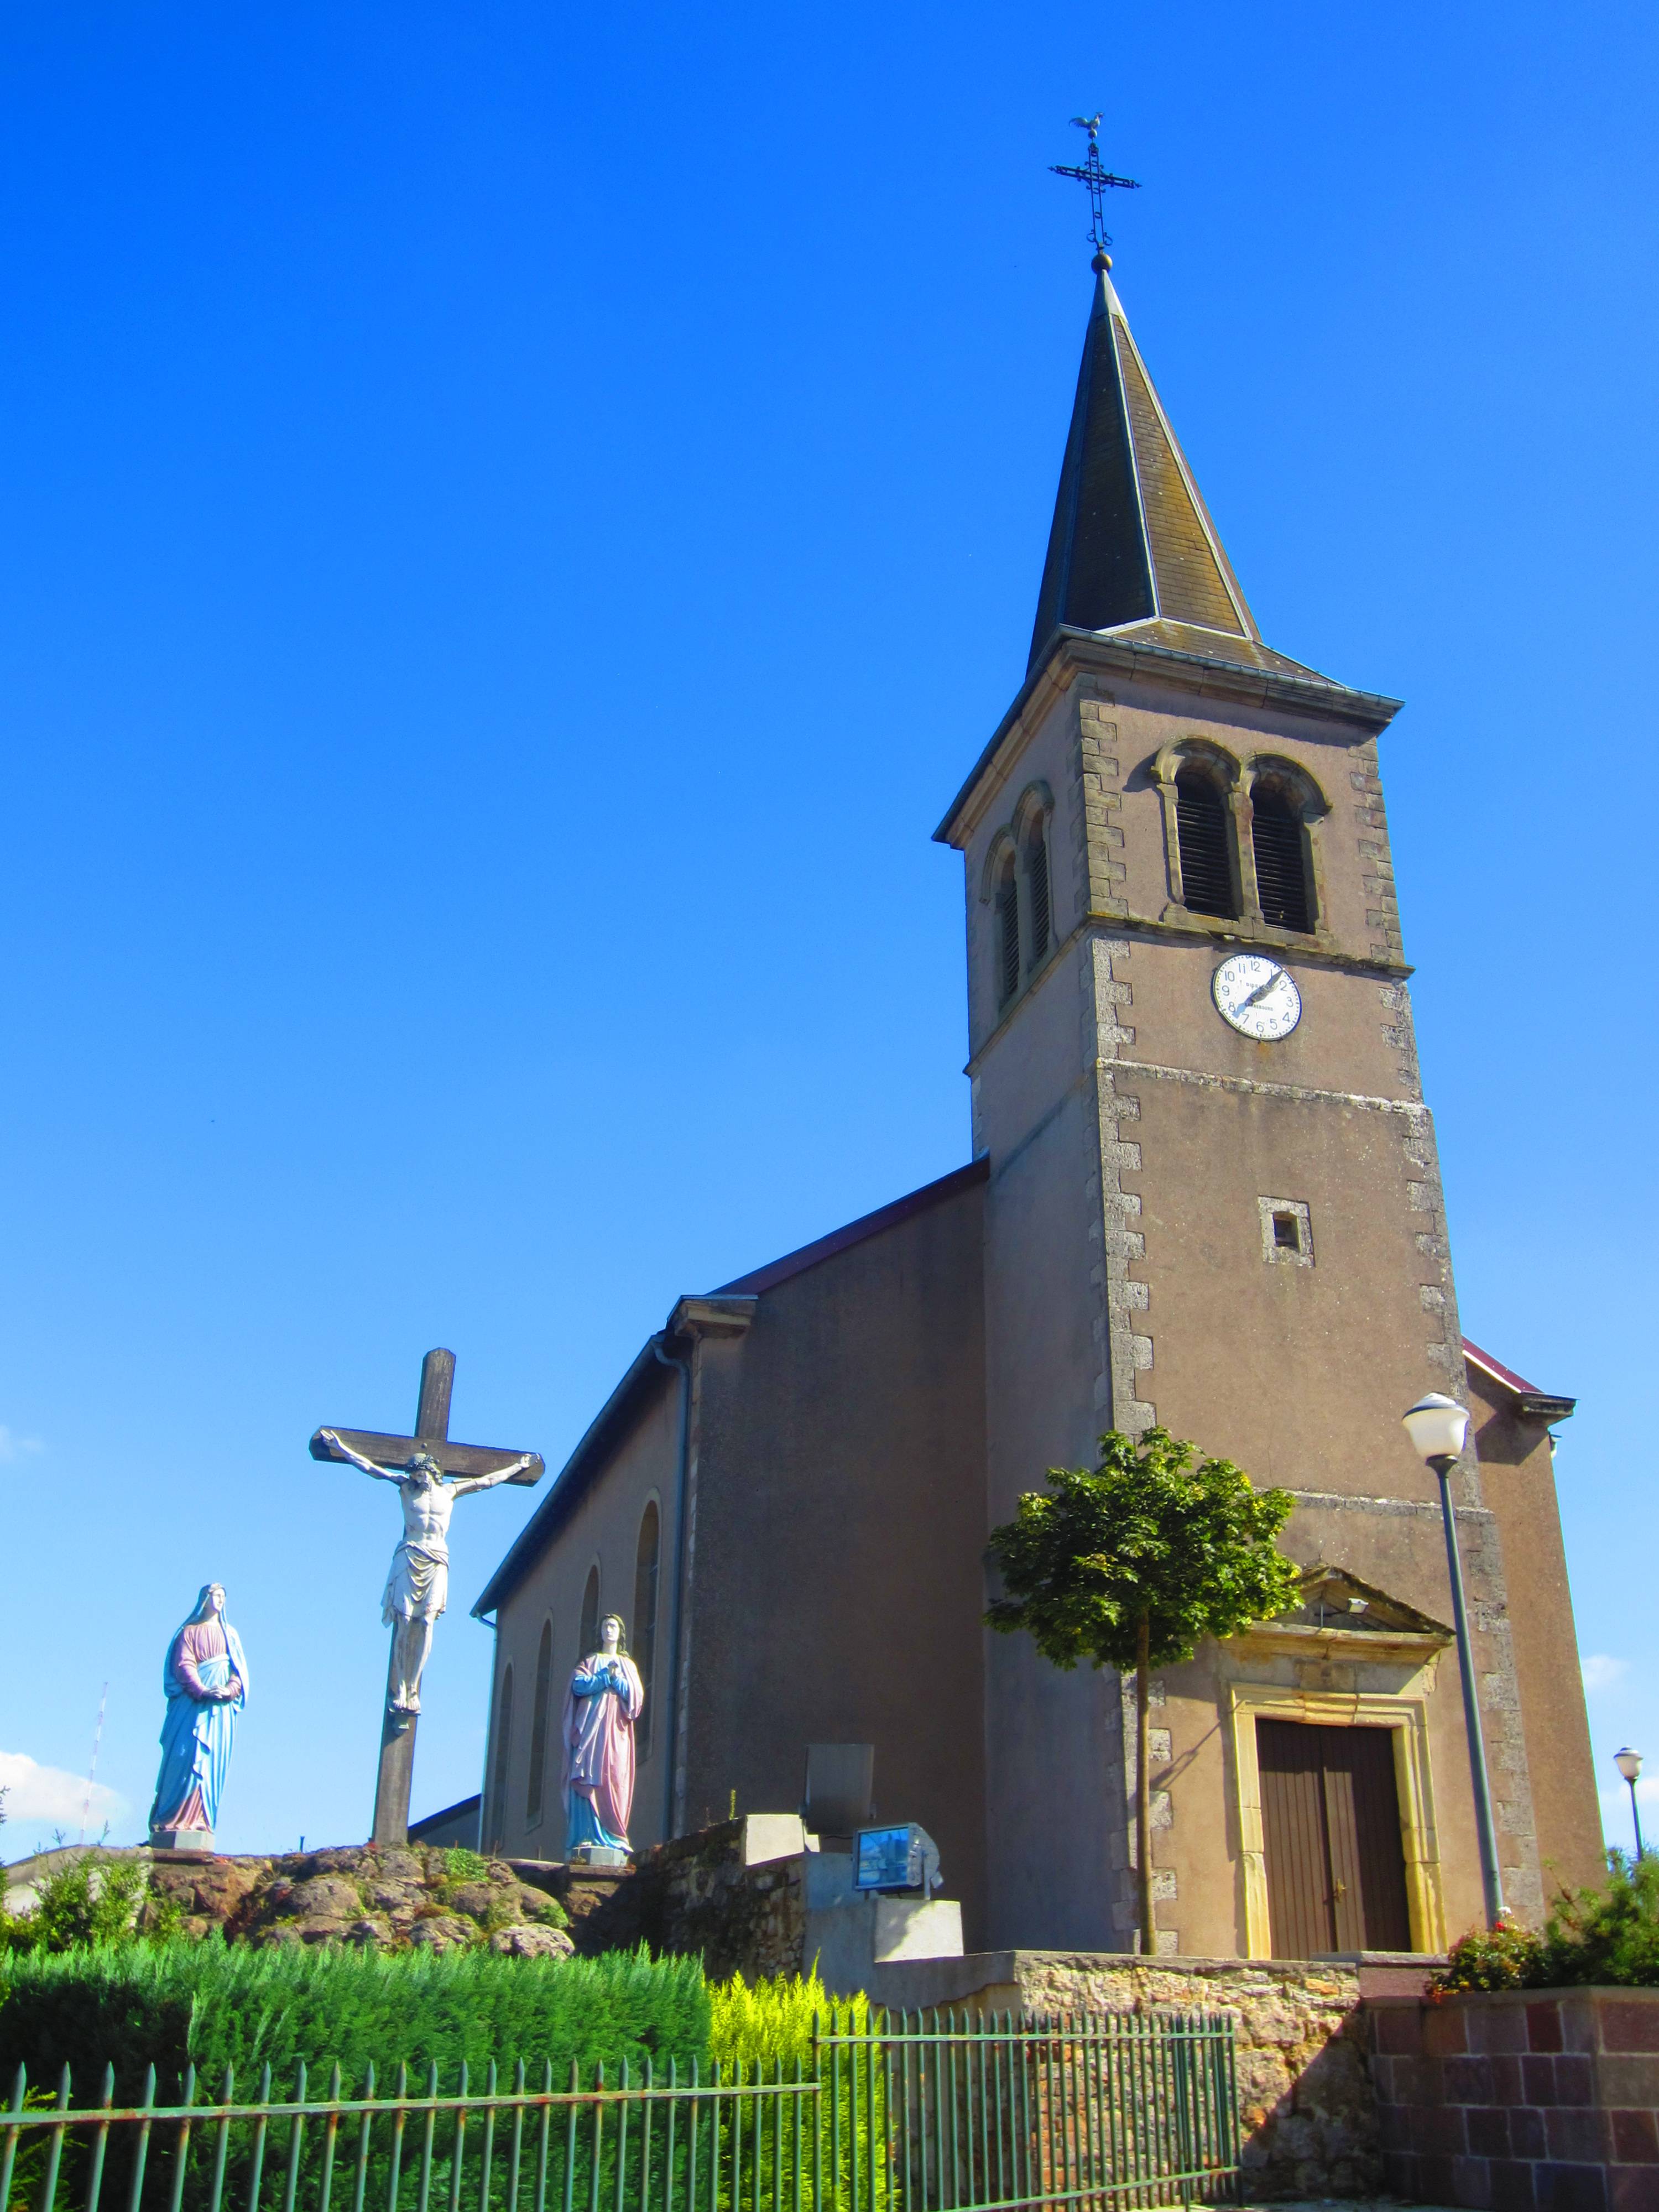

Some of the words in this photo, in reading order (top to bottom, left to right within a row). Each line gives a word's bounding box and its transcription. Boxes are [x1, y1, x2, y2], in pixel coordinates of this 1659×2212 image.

[1238, 963, 1246, 974] 11
[1250, 960, 1261, 972] 12
[1224, 971, 1235, 982] 10
[1222, 985, 1230, 997] 9
[1279, 980, 1287, 992] 2
[1228, 1001, 1236, 1013] 8
[1286, 996, 1293, 1008] 3
[1241, 1013, 1250, 1024] 7
[1282, 1011, 1290, 1023] 4
[1256, 1021, 1265, 1032] 6
[1270, 1018, 1277, 1030] 5
